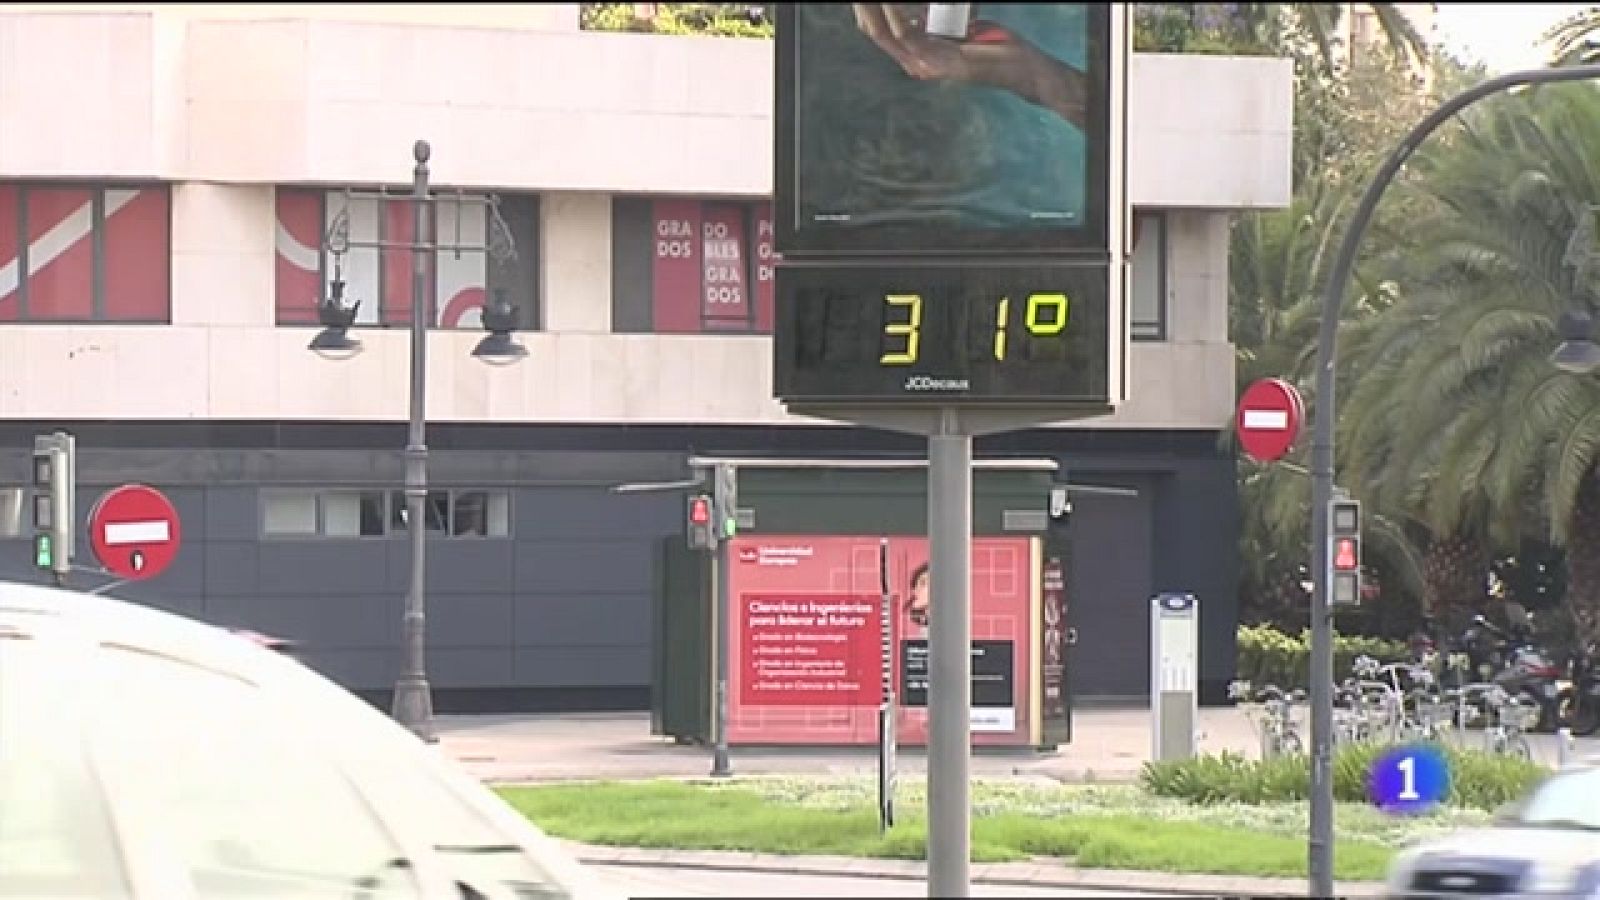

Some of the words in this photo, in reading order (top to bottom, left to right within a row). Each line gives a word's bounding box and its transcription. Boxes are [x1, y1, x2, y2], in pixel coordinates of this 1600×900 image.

[657, 219, 691, 236] GRA
[704, 222, 728, 239] DO
[657, 241, 691, 257] DOS
[707, 266, 740, 282] GRA
[706, 287, 740, 303] DOS
[905, 376, 969, 391] JCDecaux
[750, 601, 798, 613] Ciencias
[750, 616, 776, 627] para
[779, 614, 813, 625] liderar
[817, 615, 827, 626] el
[829, 614, 866, 626] futuro
